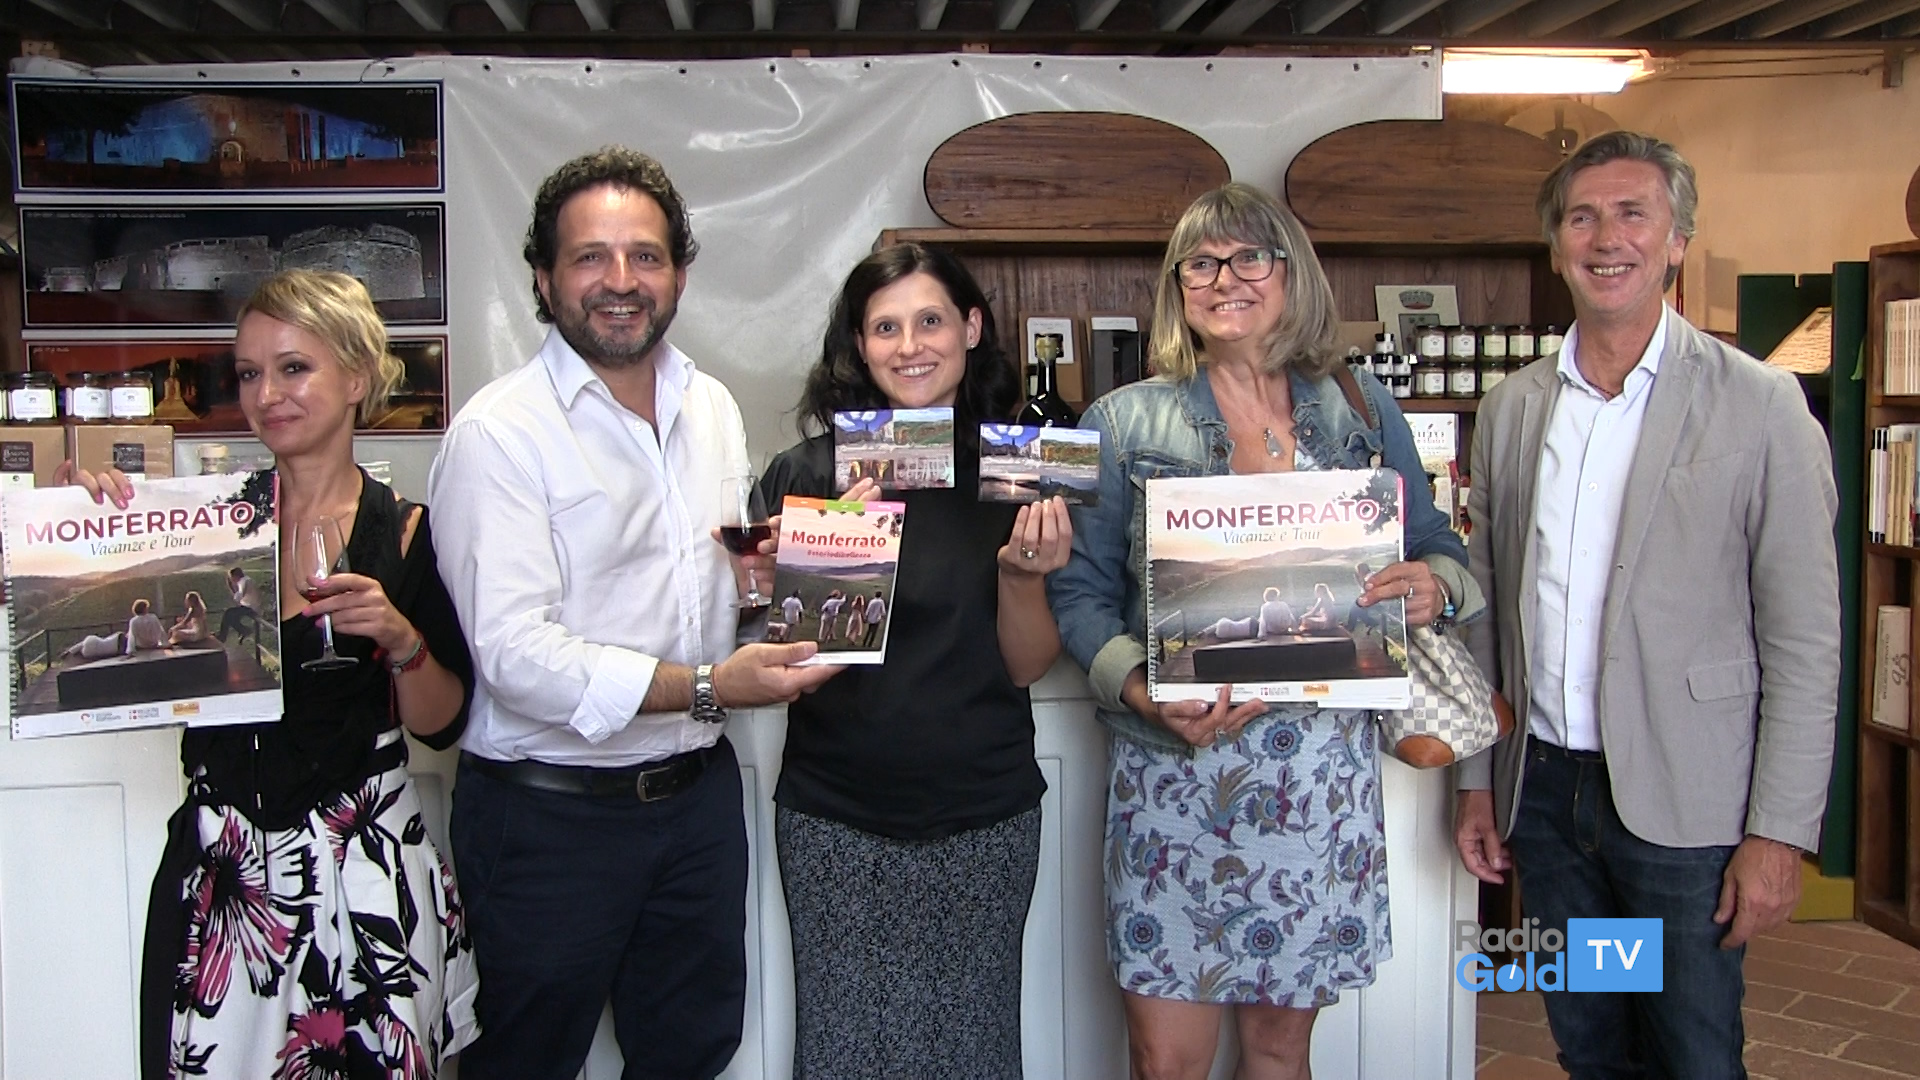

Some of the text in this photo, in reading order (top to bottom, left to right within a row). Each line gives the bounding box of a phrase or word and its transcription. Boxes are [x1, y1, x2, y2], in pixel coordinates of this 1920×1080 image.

[26, 502, 254, 546] MONFERRATO
[1166, 500, 1380, 531] MONFERRATO
[91, 533, 195, 556] Vacanze e Tour
[791, 529, 888, 548] Monferrato
[1223, 526, 1323, 545] Vacanze e Tour
